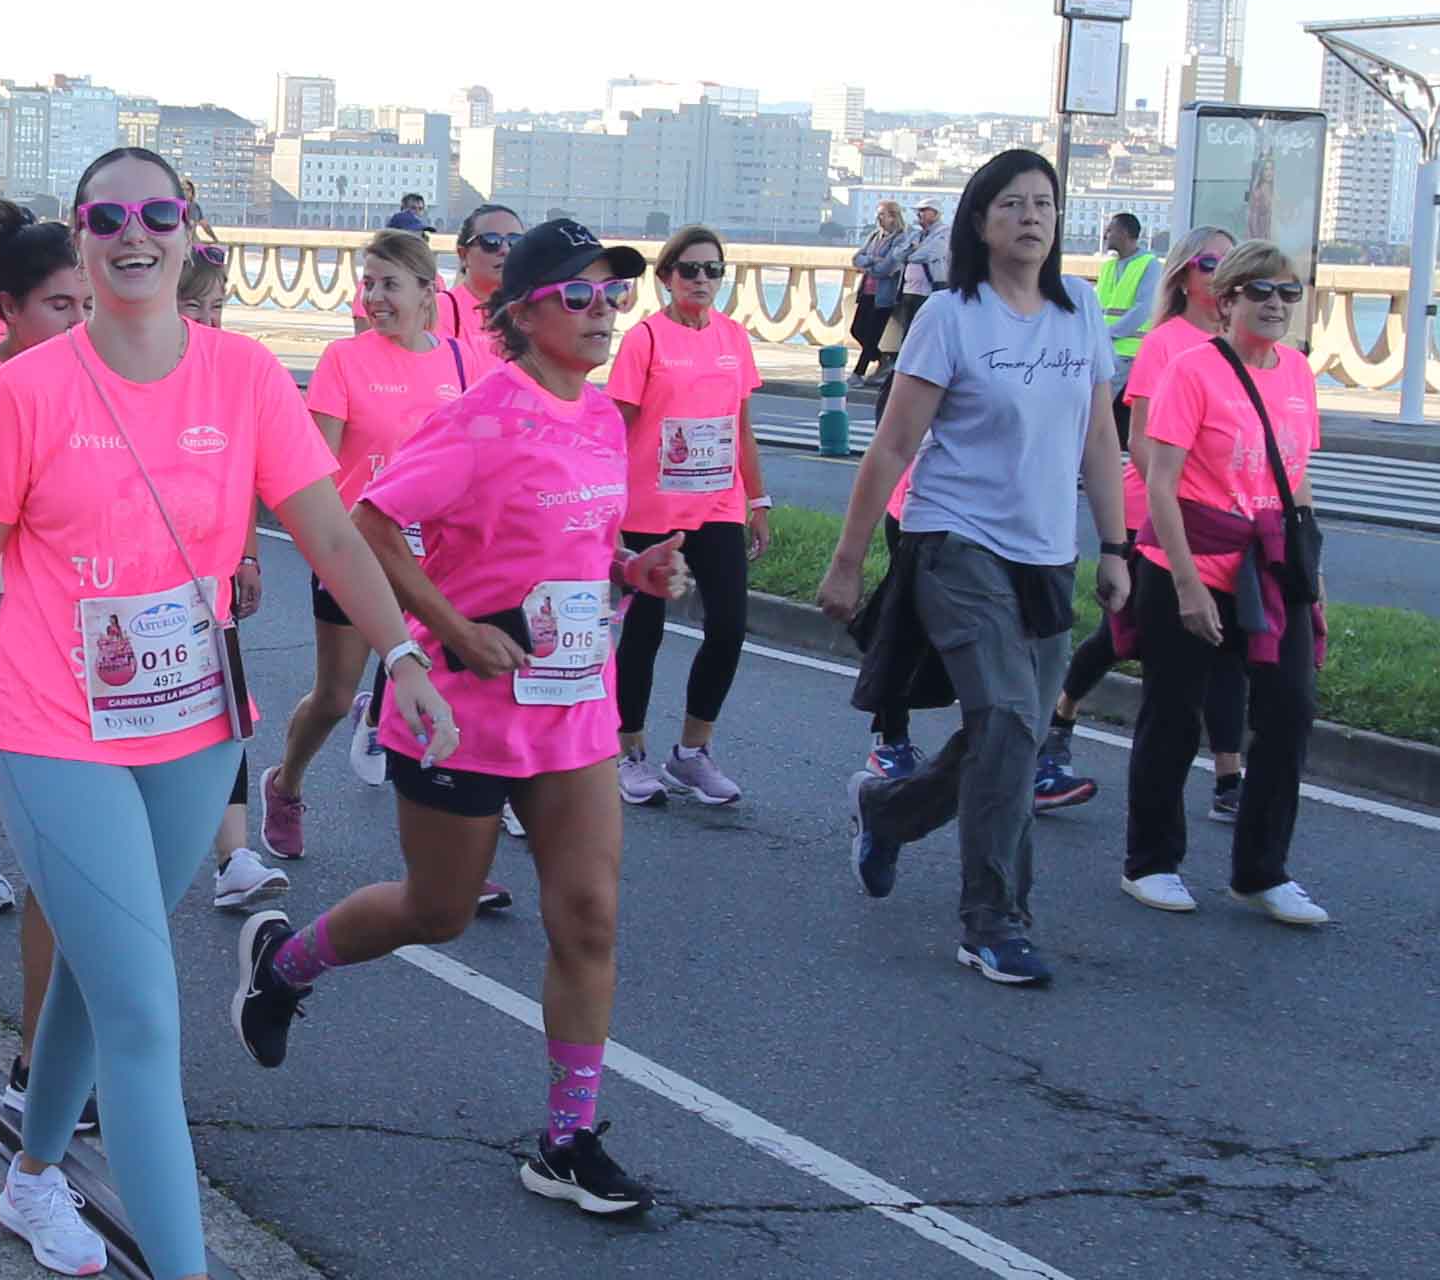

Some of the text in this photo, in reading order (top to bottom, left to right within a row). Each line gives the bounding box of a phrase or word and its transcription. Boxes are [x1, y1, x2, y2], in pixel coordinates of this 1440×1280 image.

[691, 447, 714, 458] 016
[536, 491, 580, 510] Sports
[72, 555, 114, 590] TU
[562, 631, 593, 648] 016
[141, 644, 188, 670] 016
[152, 671, 183, 688] 4972
[108, 693, 152, 708] CARRERA
[153, 692, 167, 705] DE
